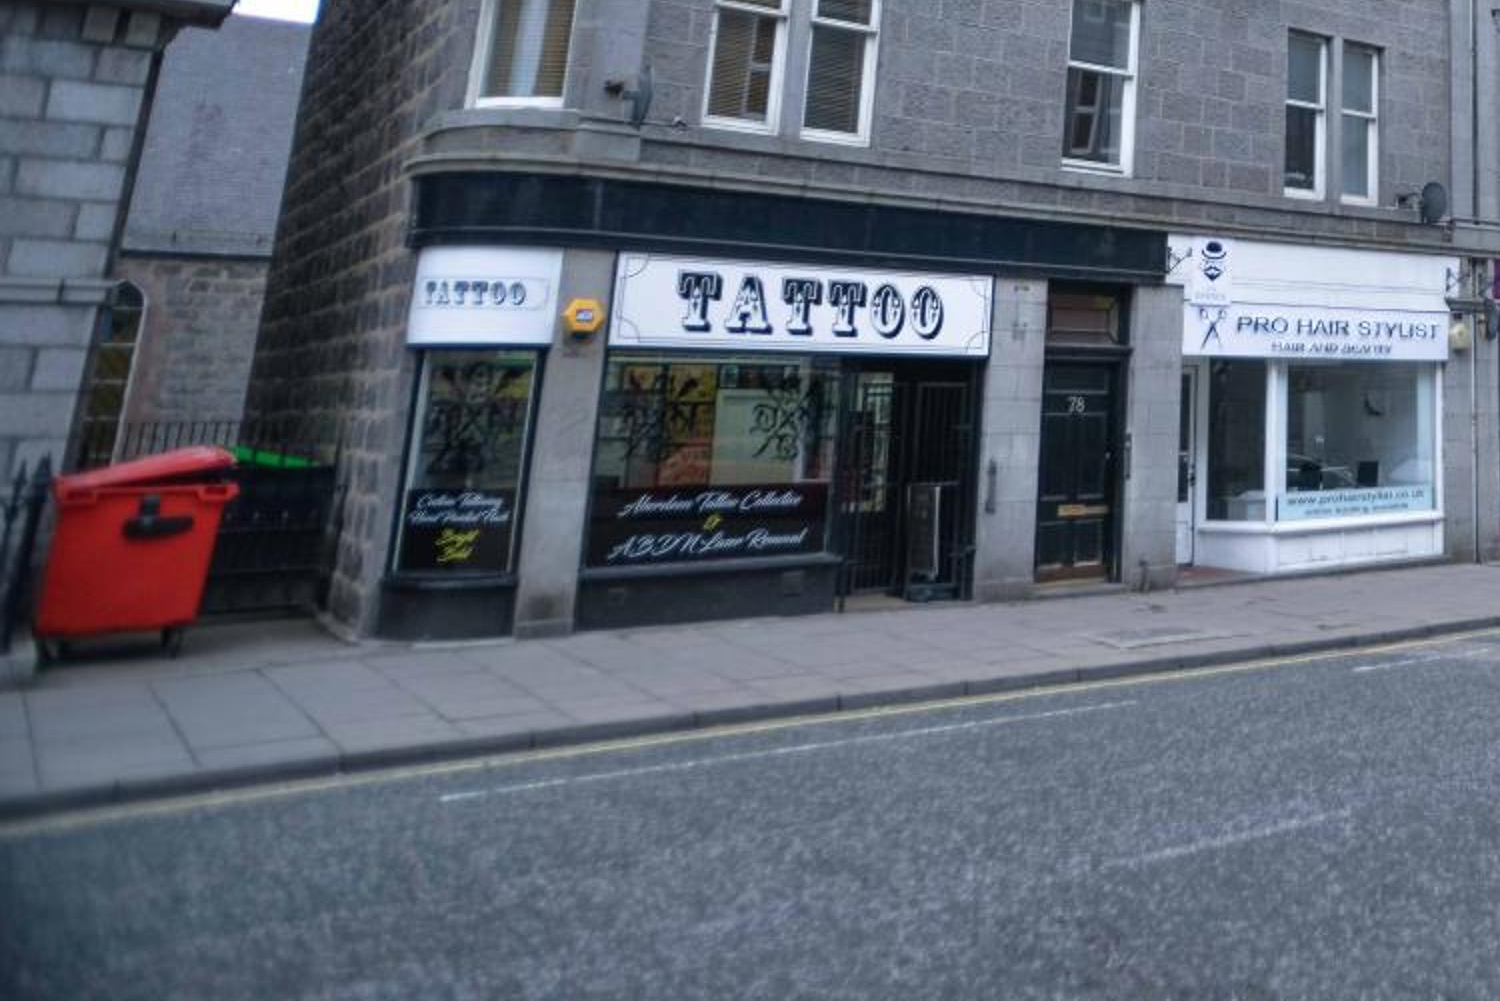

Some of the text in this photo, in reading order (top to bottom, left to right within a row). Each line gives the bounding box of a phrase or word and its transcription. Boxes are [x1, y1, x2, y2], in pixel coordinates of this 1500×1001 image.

[425, 280, 527, 306] TATTOO
[677, 270, 945, 340] TATTOO
[1237, 316, 1440, 340] PRO HAIR STYLIST
[1069, 396, 1085, 412] 78
